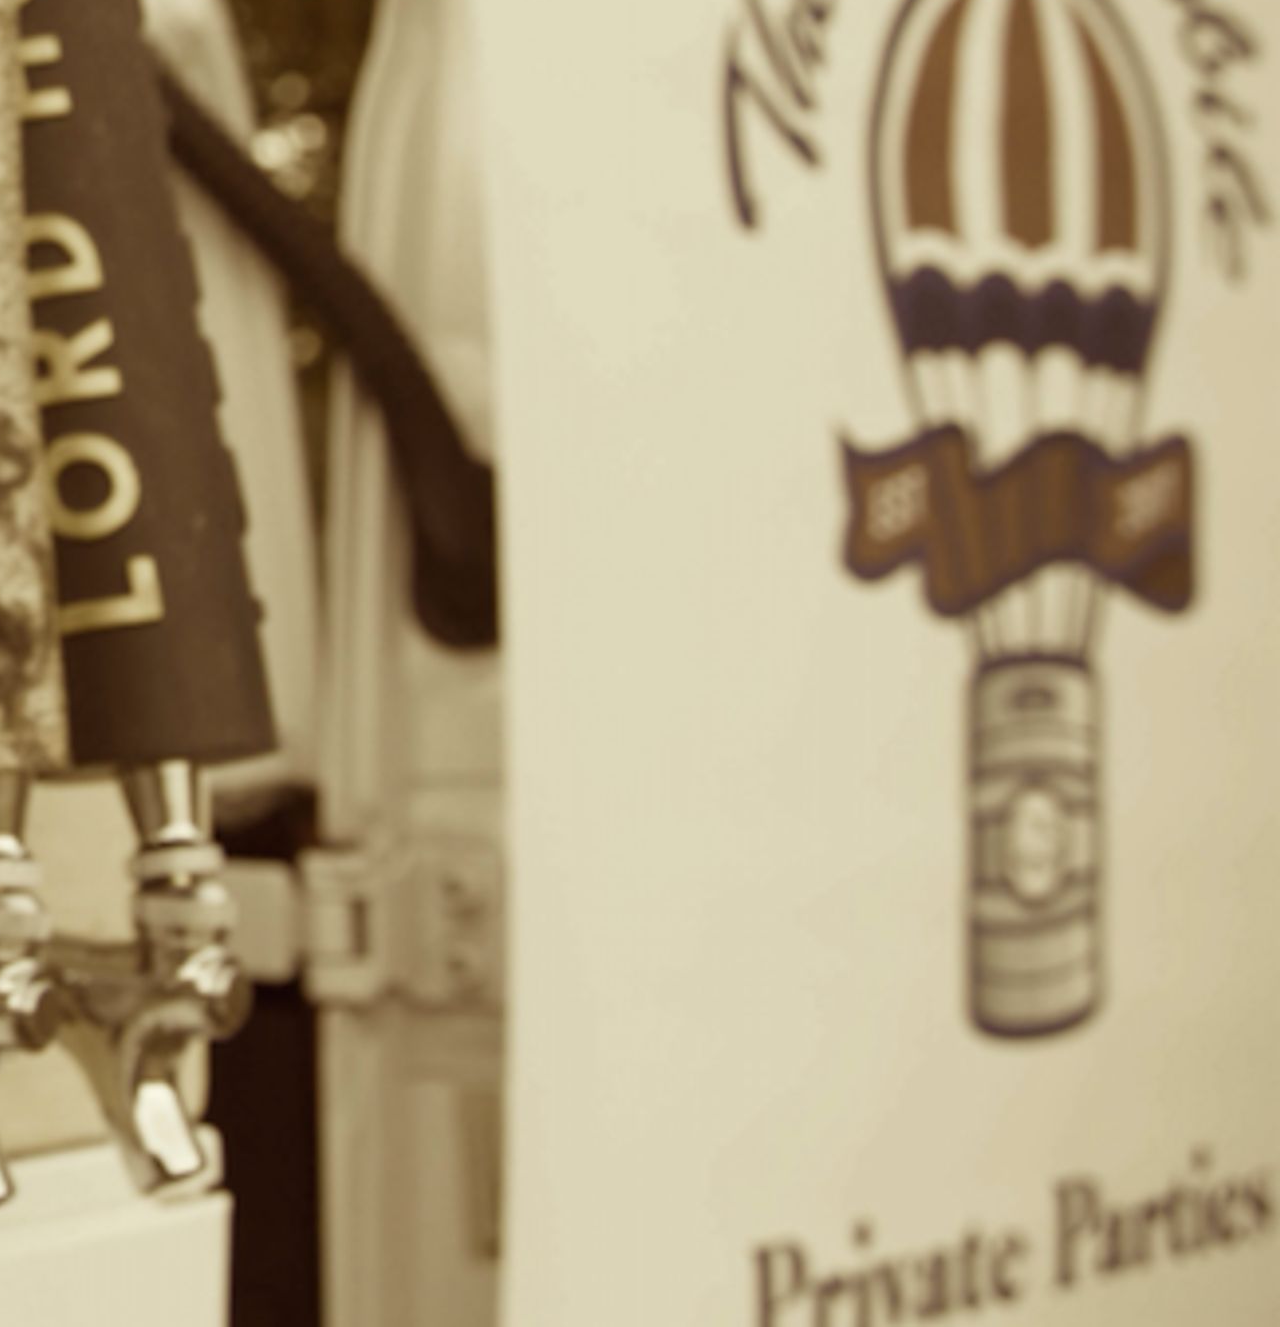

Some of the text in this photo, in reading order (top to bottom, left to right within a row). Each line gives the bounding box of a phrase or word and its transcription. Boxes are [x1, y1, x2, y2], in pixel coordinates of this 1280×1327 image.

[23, 211, 164, 636] LORD
[754, 1144, 1272, 1327] Private Parties
